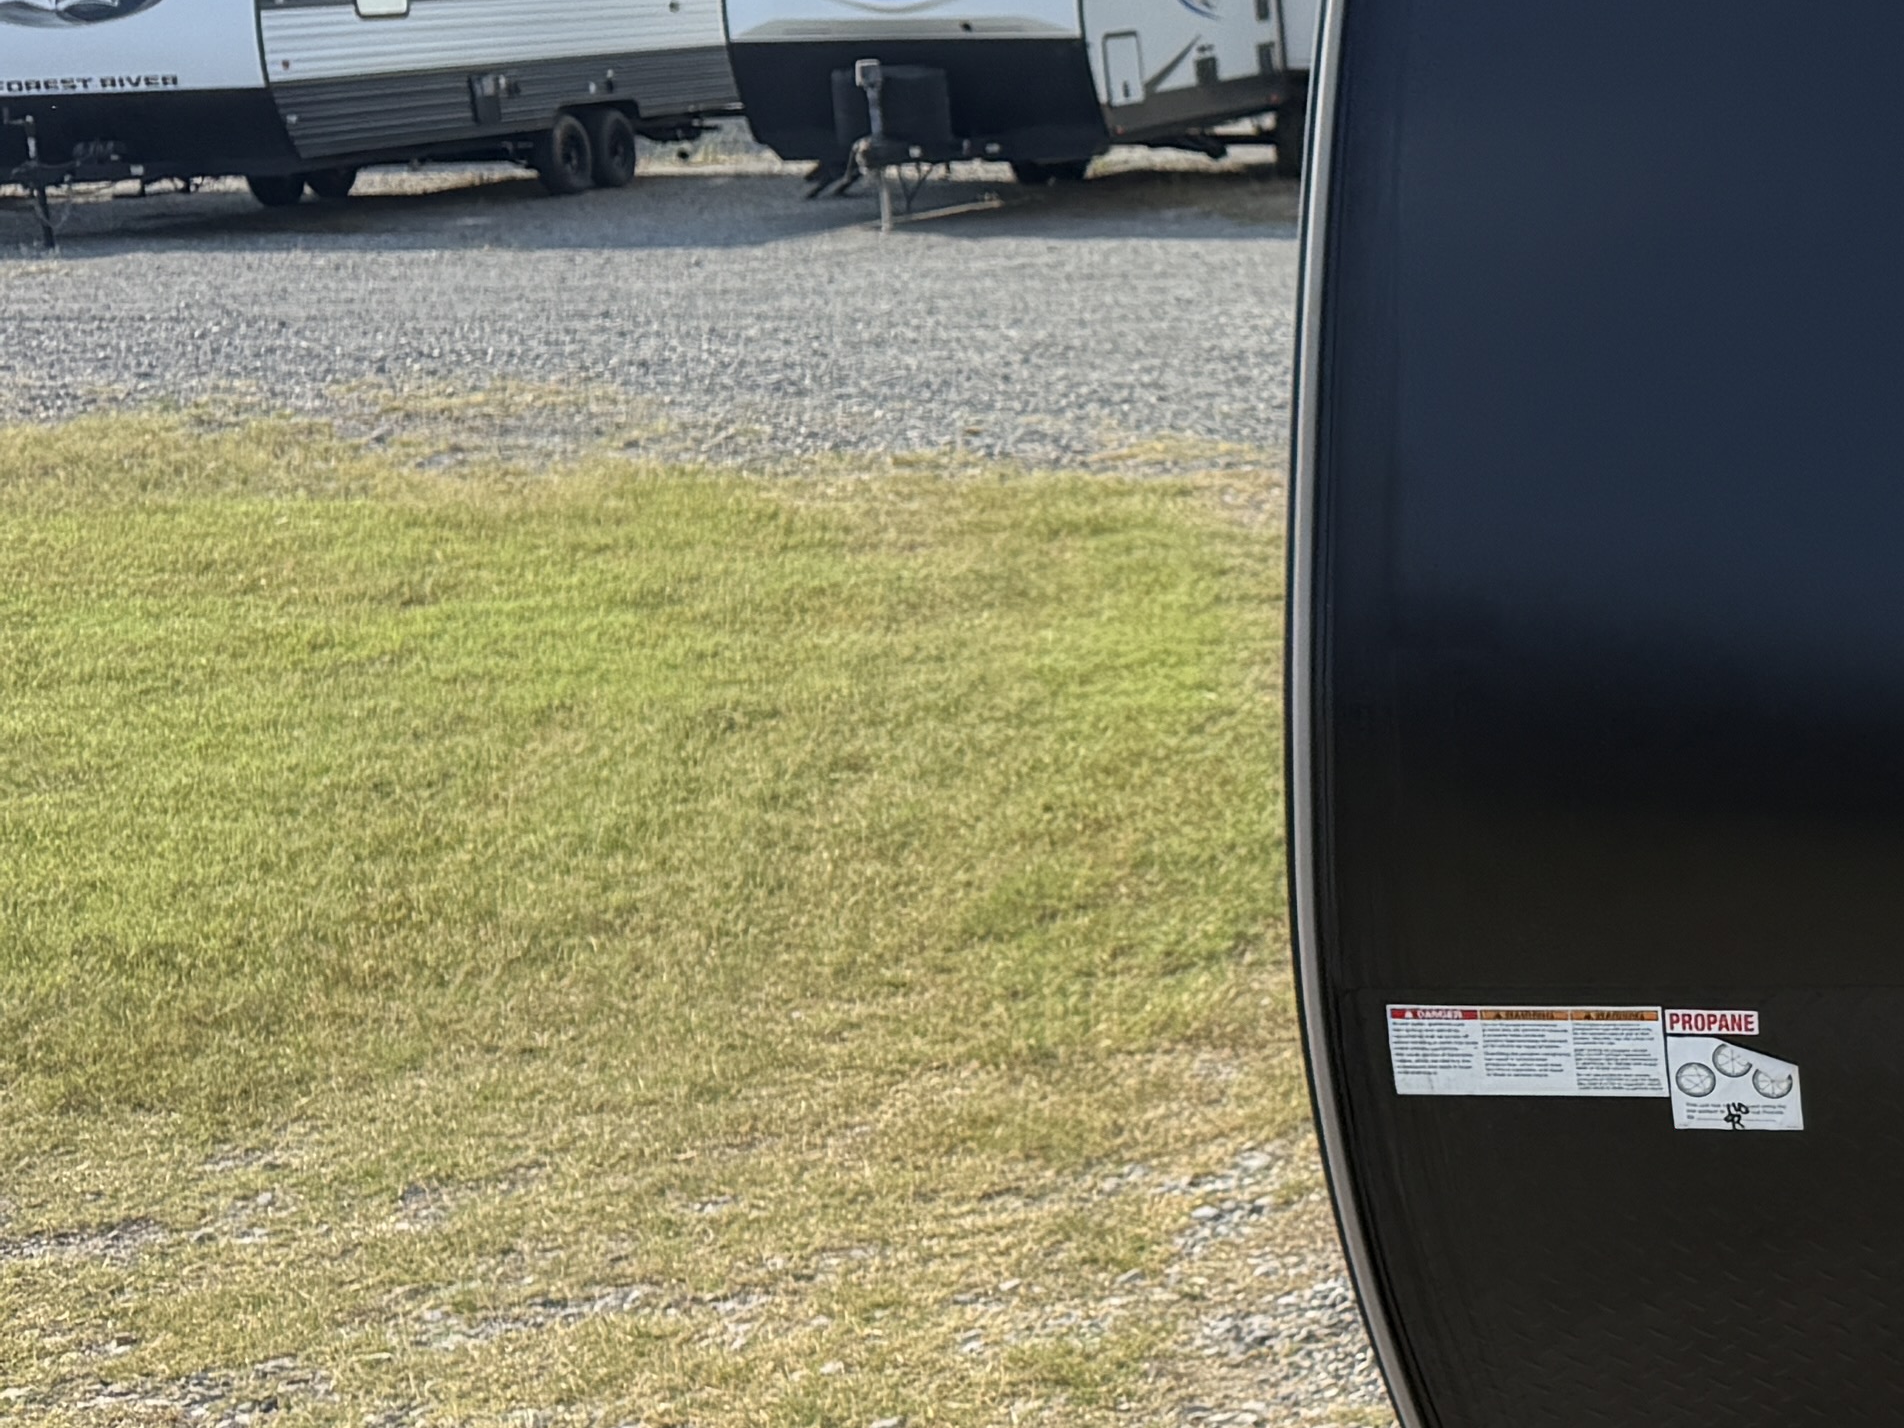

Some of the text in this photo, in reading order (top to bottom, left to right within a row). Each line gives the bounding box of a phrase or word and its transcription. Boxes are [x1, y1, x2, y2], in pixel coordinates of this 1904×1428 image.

[0, 74, 179, 93] OREST RIVER
[1669, 1013, 1755, 1032] PROPANE
